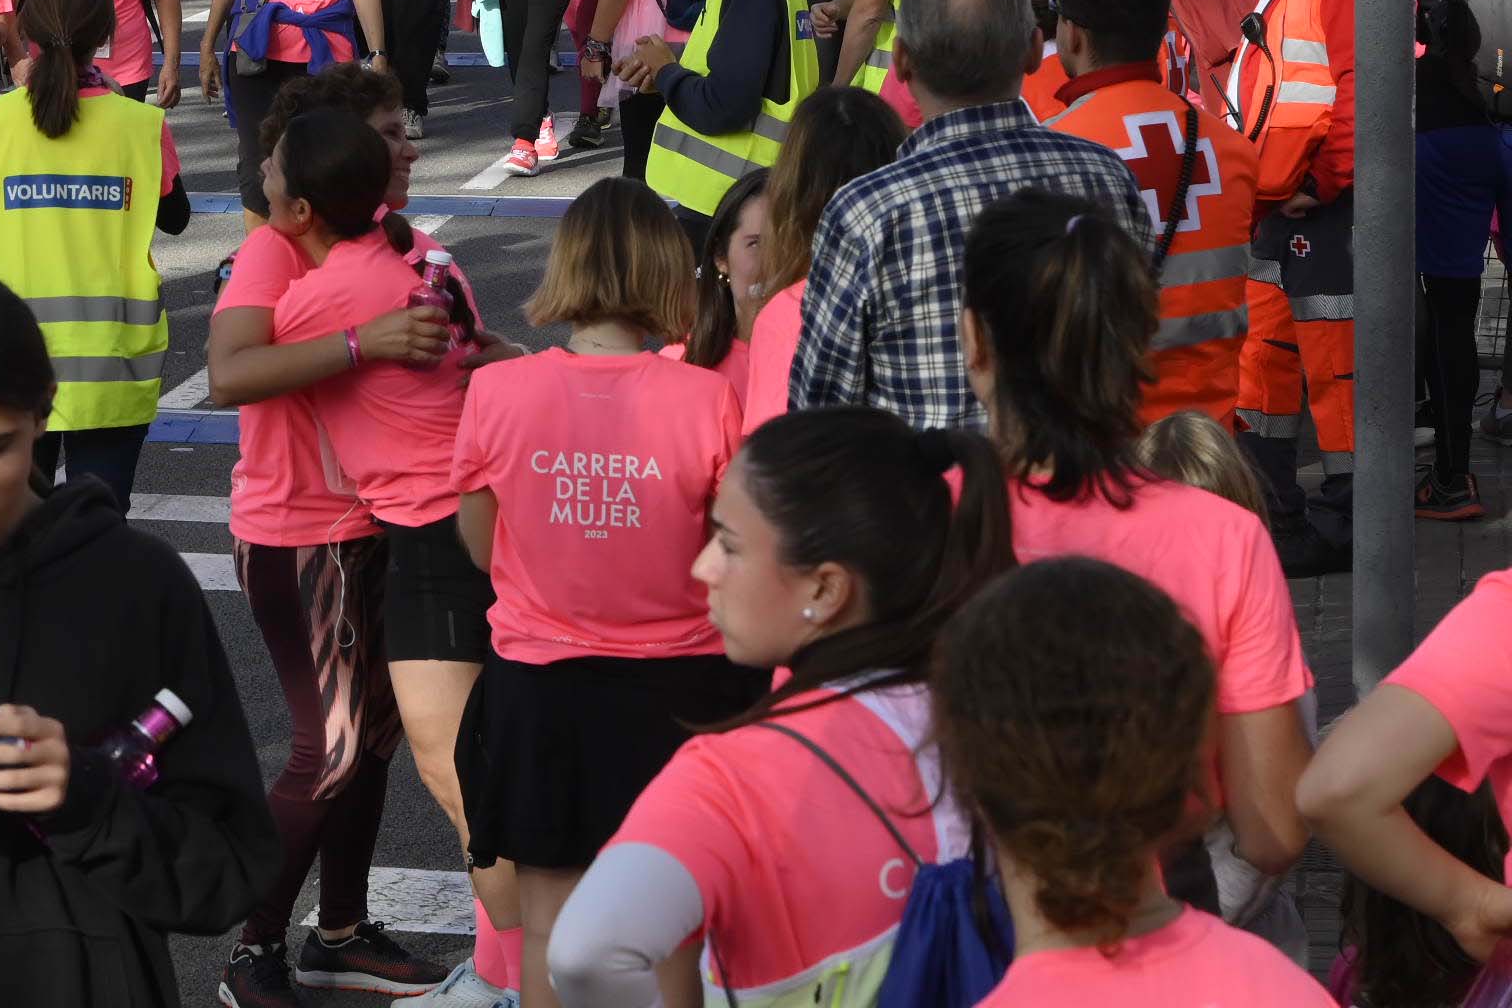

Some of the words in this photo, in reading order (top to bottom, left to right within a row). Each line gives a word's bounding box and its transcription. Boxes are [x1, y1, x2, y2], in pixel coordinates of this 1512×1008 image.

[7, 183, 121, 201] VOLUNTARIS
[530, 449, 663, 481] CARRERA
[556, 477, 590, 501] DE
[602, 480, 636, 503] LA
[548, 501, 641, 529] MUJER
